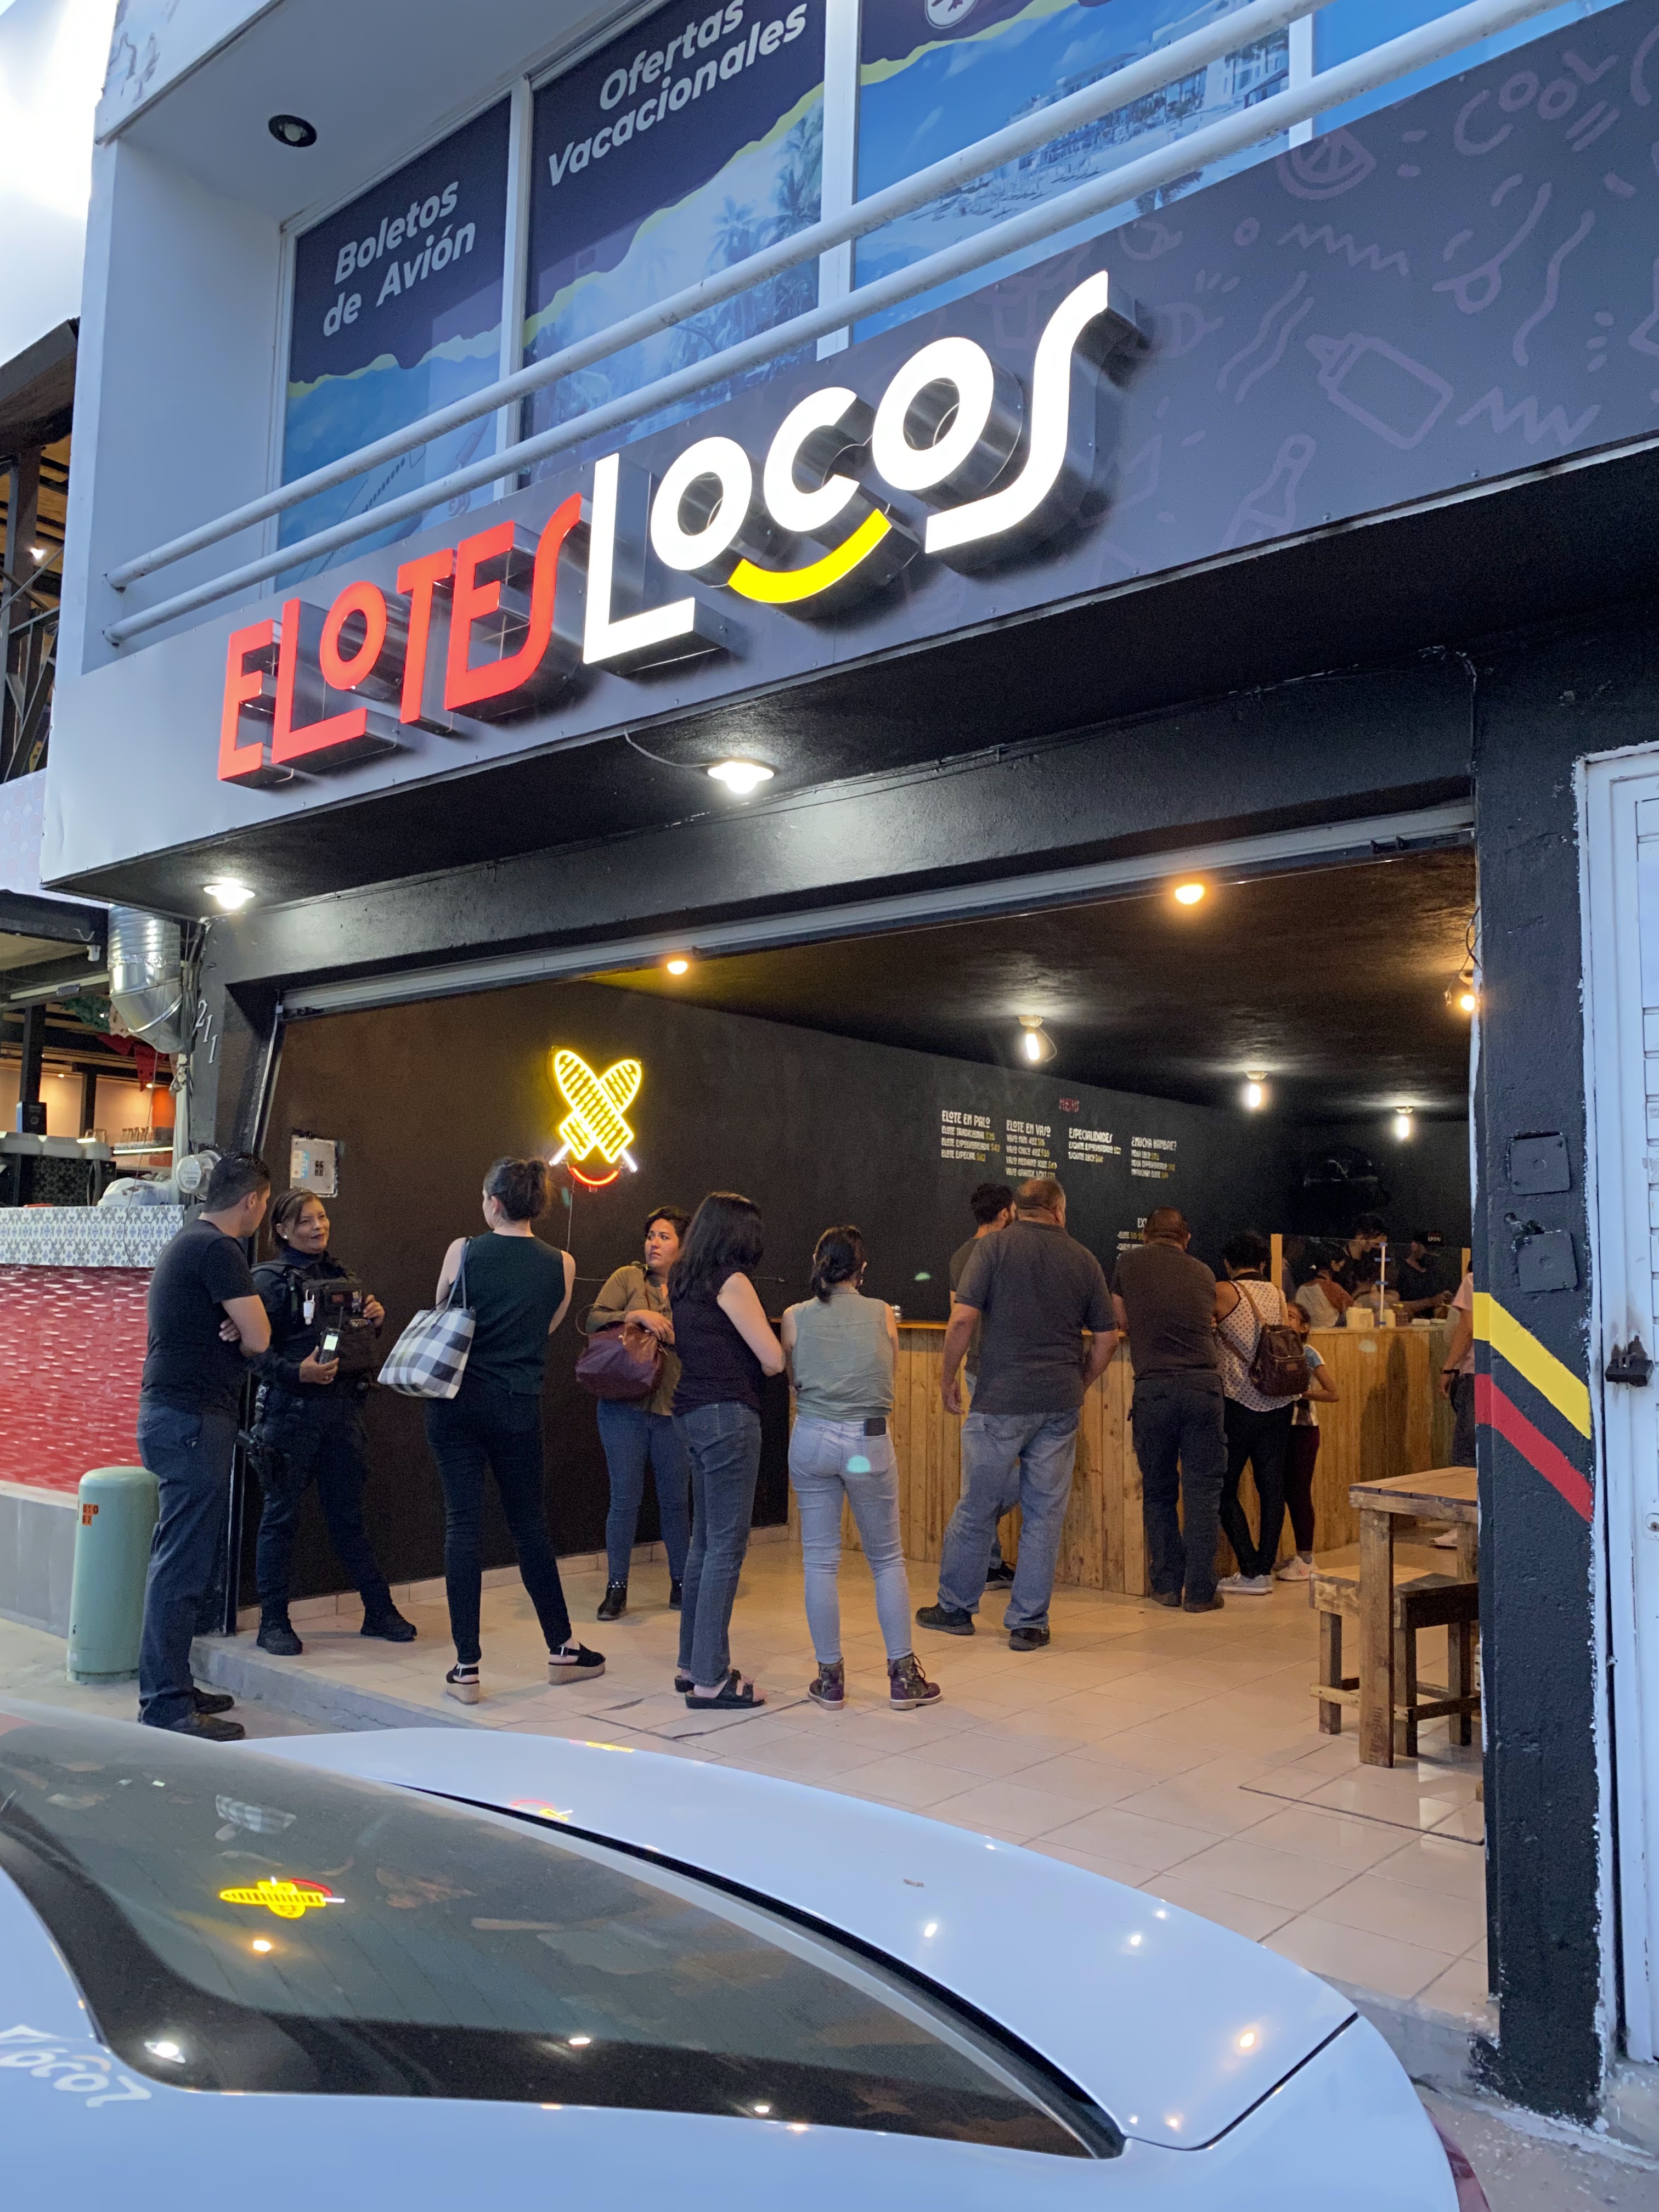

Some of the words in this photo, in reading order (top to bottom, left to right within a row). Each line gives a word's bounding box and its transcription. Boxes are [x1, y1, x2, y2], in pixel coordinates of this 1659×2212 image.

[549, 3, 808, 187] Vacacionales
[600, 0, 744, 110] Ofertas
[323, 291, 362, 337] de
[375, 222, 476, 308] Avión
[334, 180, 459, 285] Boletos
[217, 492, 582, 782] ELOTES
[583, 270, 1109, 665] LOCOS
[941, 1110, 962, 1124] ELOTE
[963, 1113, 972, 1125] EN
[974, 1115, 991, 1128] PALO
[1006, 1120, 1024, 1133] ELOTE
[1026, 1123, 1034, 1135] EN
[1036, 1124, 1051, 1137] VASO
[1069, 1127, 1113, 1143] ESPECIALIDADES
